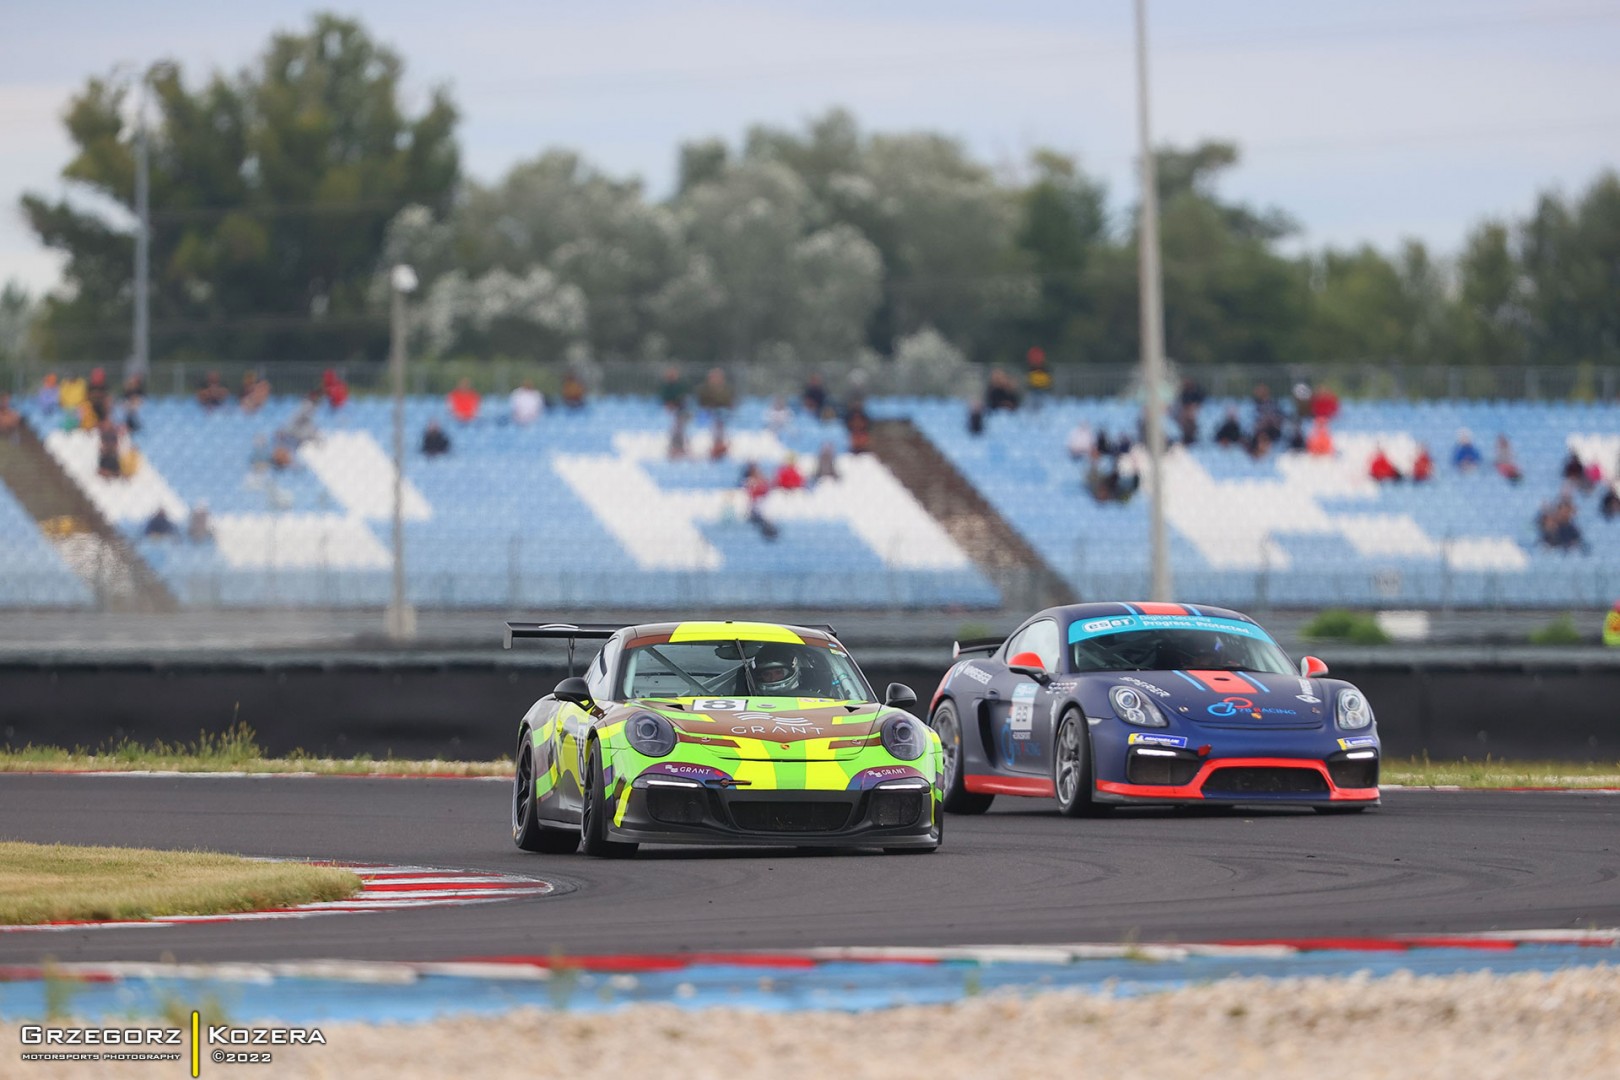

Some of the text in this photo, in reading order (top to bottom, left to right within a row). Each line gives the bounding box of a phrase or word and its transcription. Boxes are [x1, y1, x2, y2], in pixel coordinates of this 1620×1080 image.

[702, 699, 736, 710] 8
[1253, 707, 1297, 715] RACING
[731, 726, 824, 735] GRANT
[680, 766, 711, 775] GRANT
[881, 767, 907, 776] GRANT
